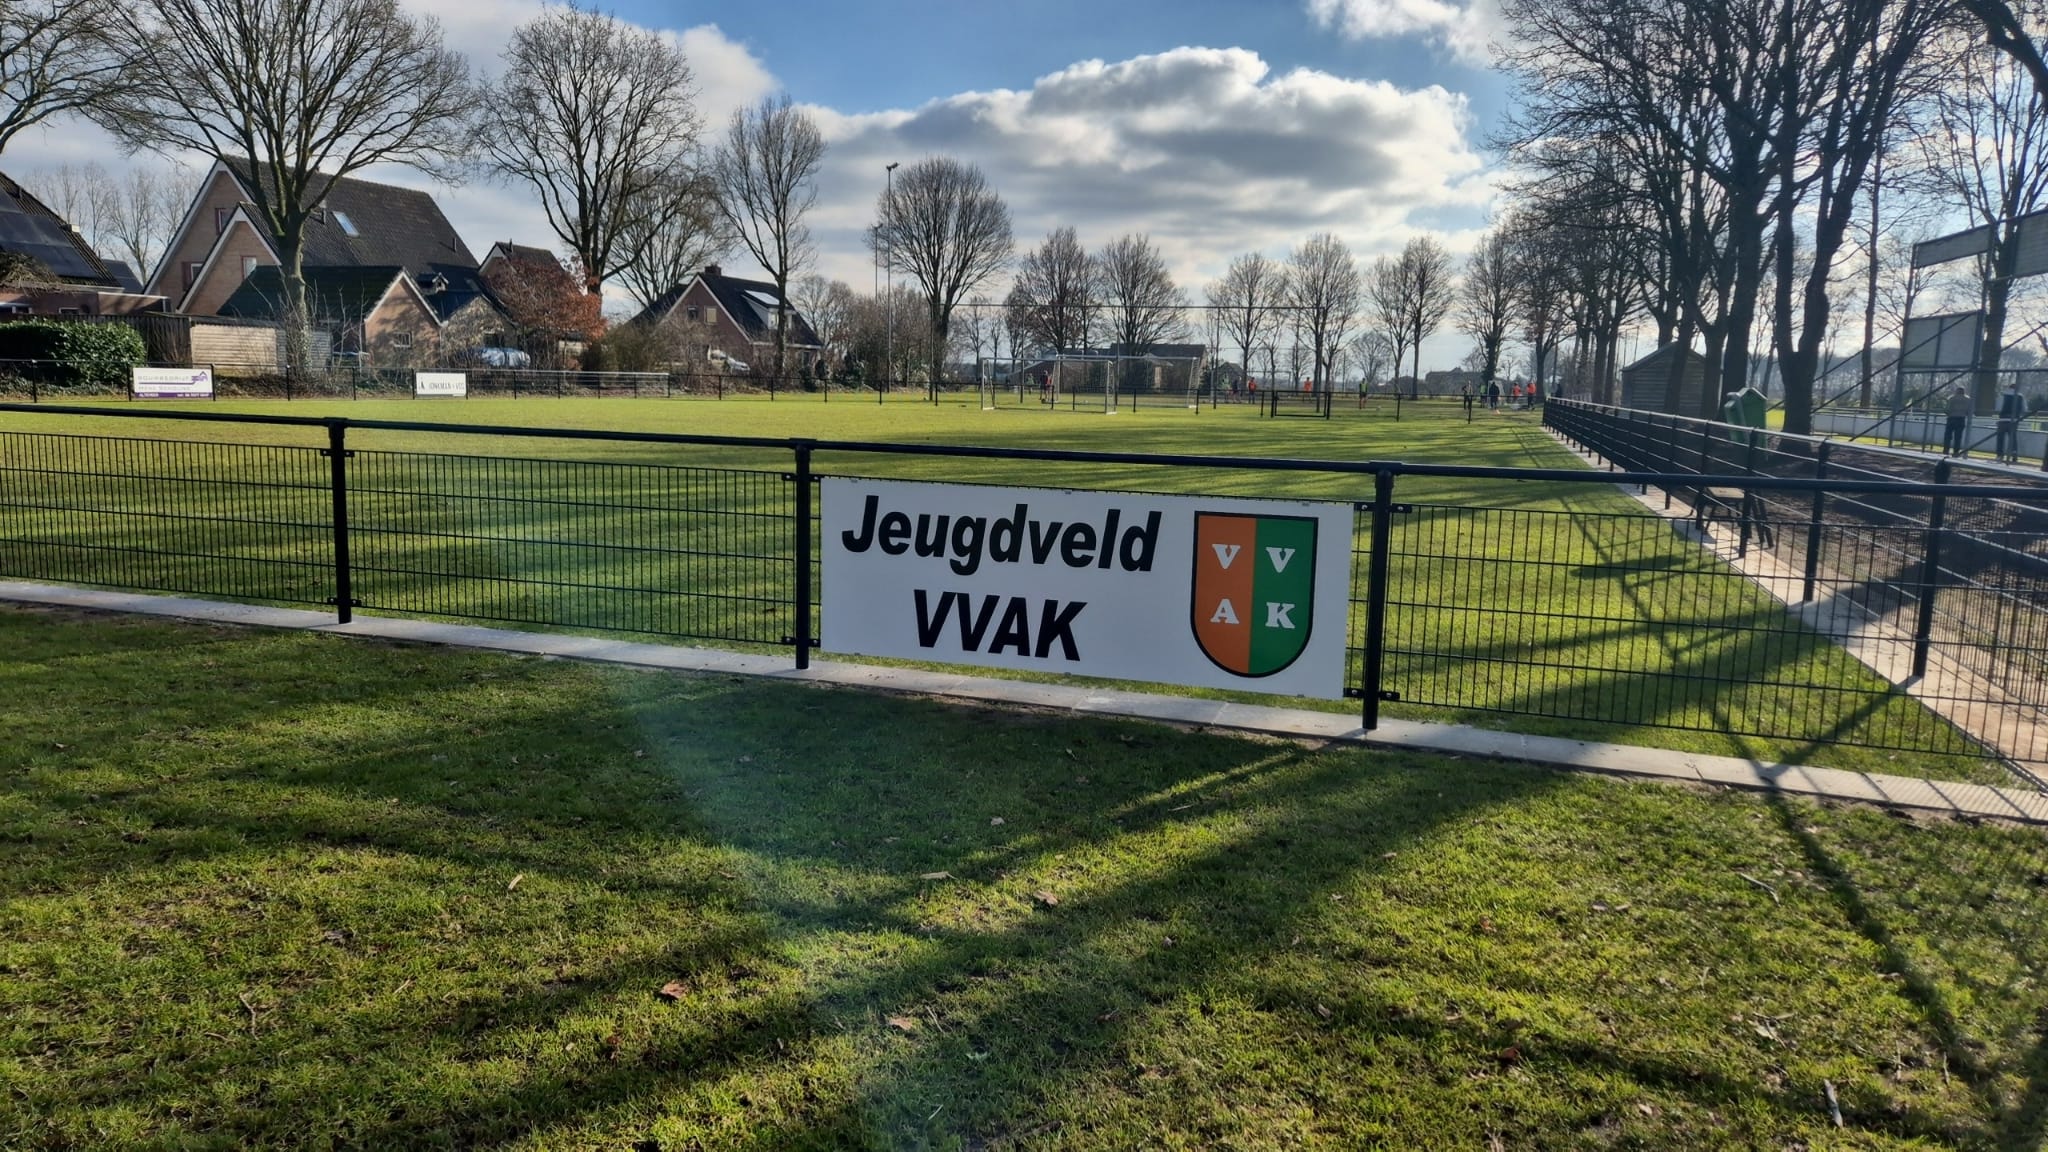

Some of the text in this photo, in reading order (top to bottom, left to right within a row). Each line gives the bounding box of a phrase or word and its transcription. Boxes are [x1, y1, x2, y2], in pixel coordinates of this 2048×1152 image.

[842, 495, 1162, 576] Jeugdveld
[1212, 543, 1296, 573] V V
[914, 589, 1088, 662] VVAK
[1210, 598, 1296, 629] A K
